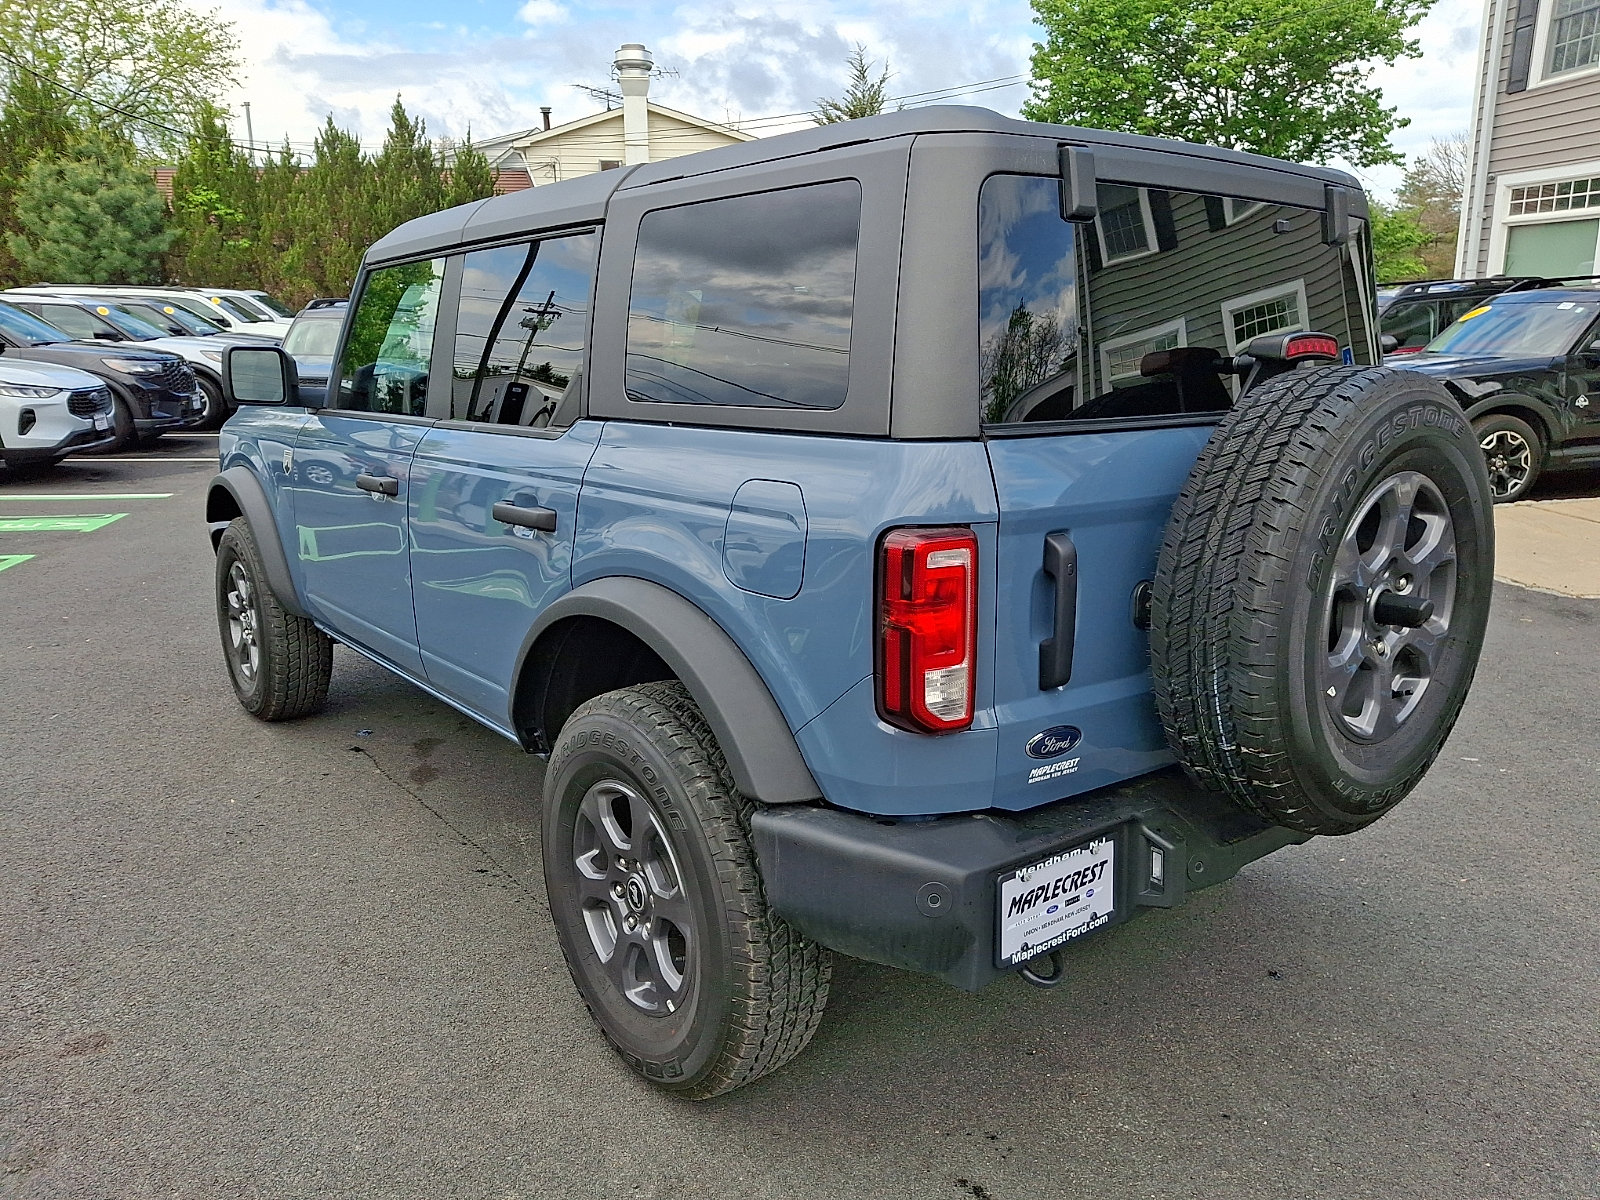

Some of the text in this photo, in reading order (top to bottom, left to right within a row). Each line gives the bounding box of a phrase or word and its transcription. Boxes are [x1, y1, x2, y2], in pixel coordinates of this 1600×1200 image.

[1306, 406, 1466, 593] BRIDGESTONE
[551, 728, 687, 833] BRIDGESTONE
[1029, 757, 1080, 778] MAPLECREST
[1015, 837, 1106, 879] Mendham, NJ
[1007, 859, 1108, 918] MAPLECREST
[1011, 915, 1109, 965] MaplecrestFord.com
[1023, 927, 1038, 938] UNION
